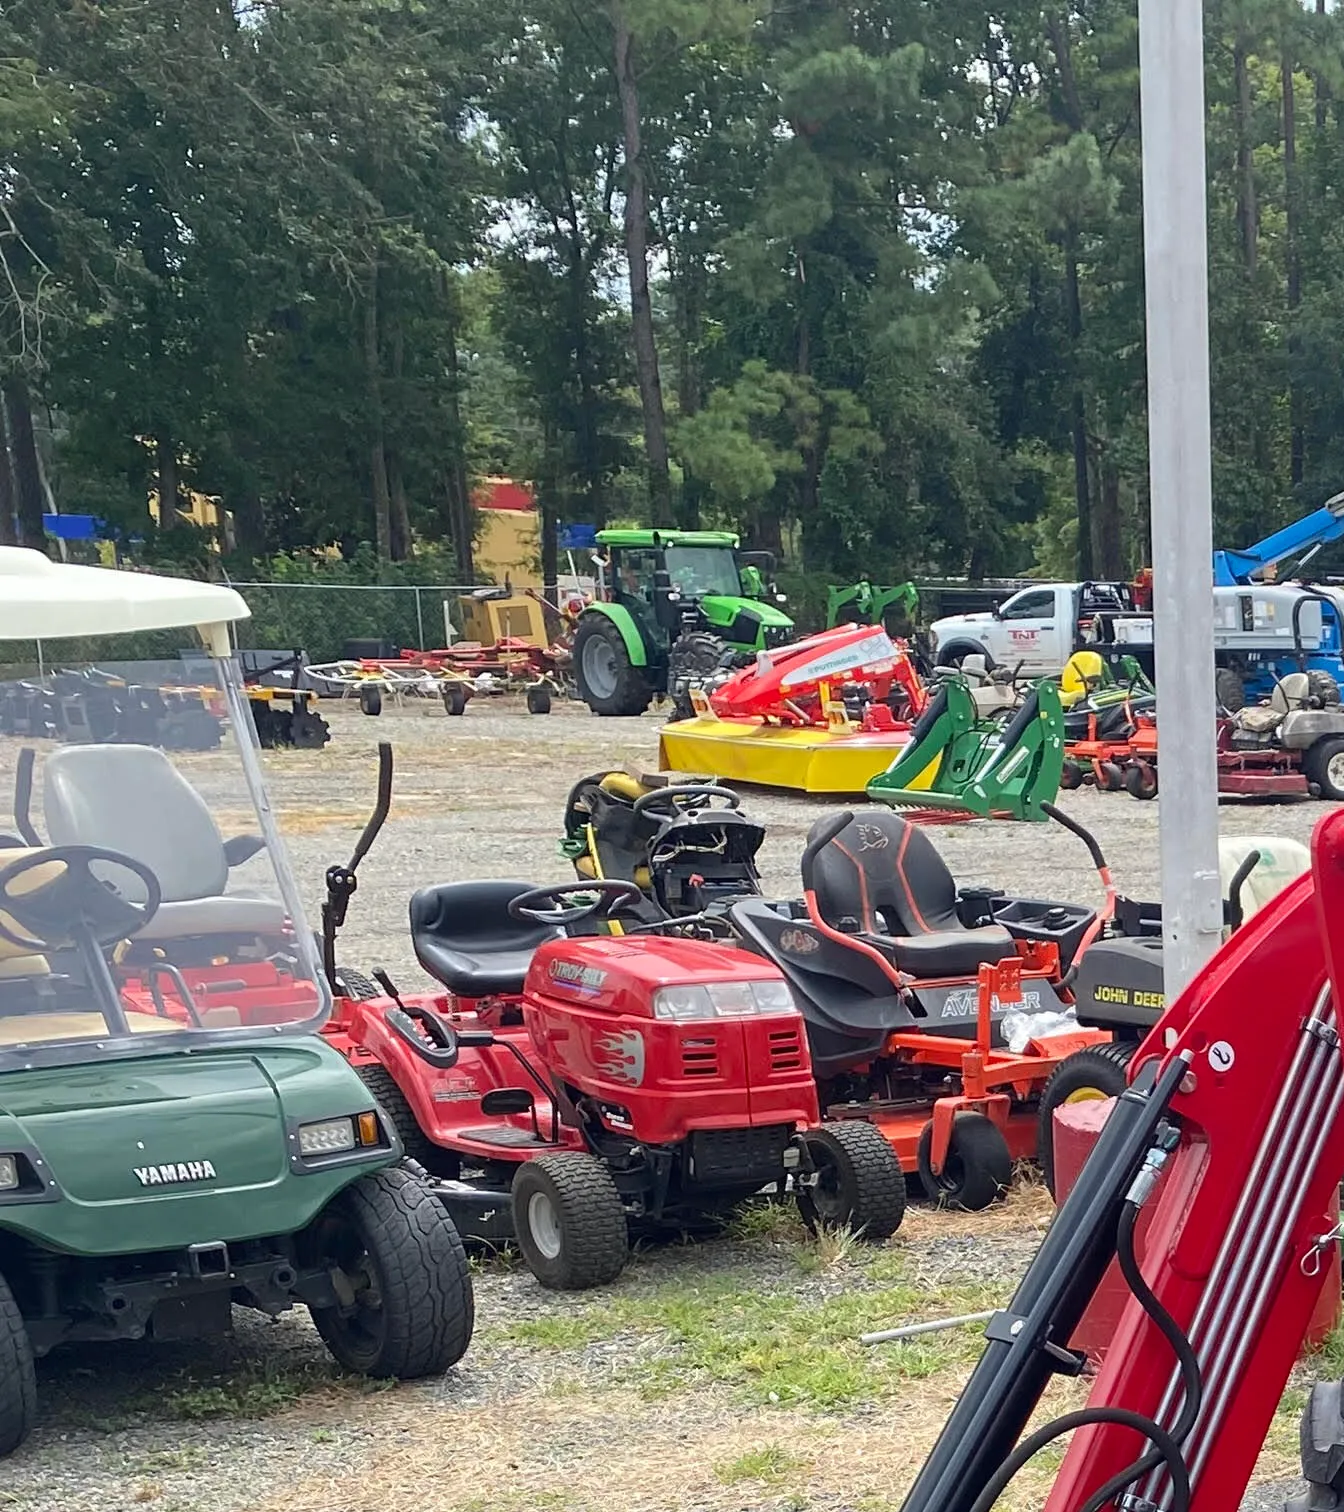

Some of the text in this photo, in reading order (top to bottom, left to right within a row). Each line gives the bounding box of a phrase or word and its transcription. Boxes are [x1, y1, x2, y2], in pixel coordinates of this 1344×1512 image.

[1094, 985, 1165, 1009] JOHN DEER
[133, 1160, 217, 1186] YAMAHA
